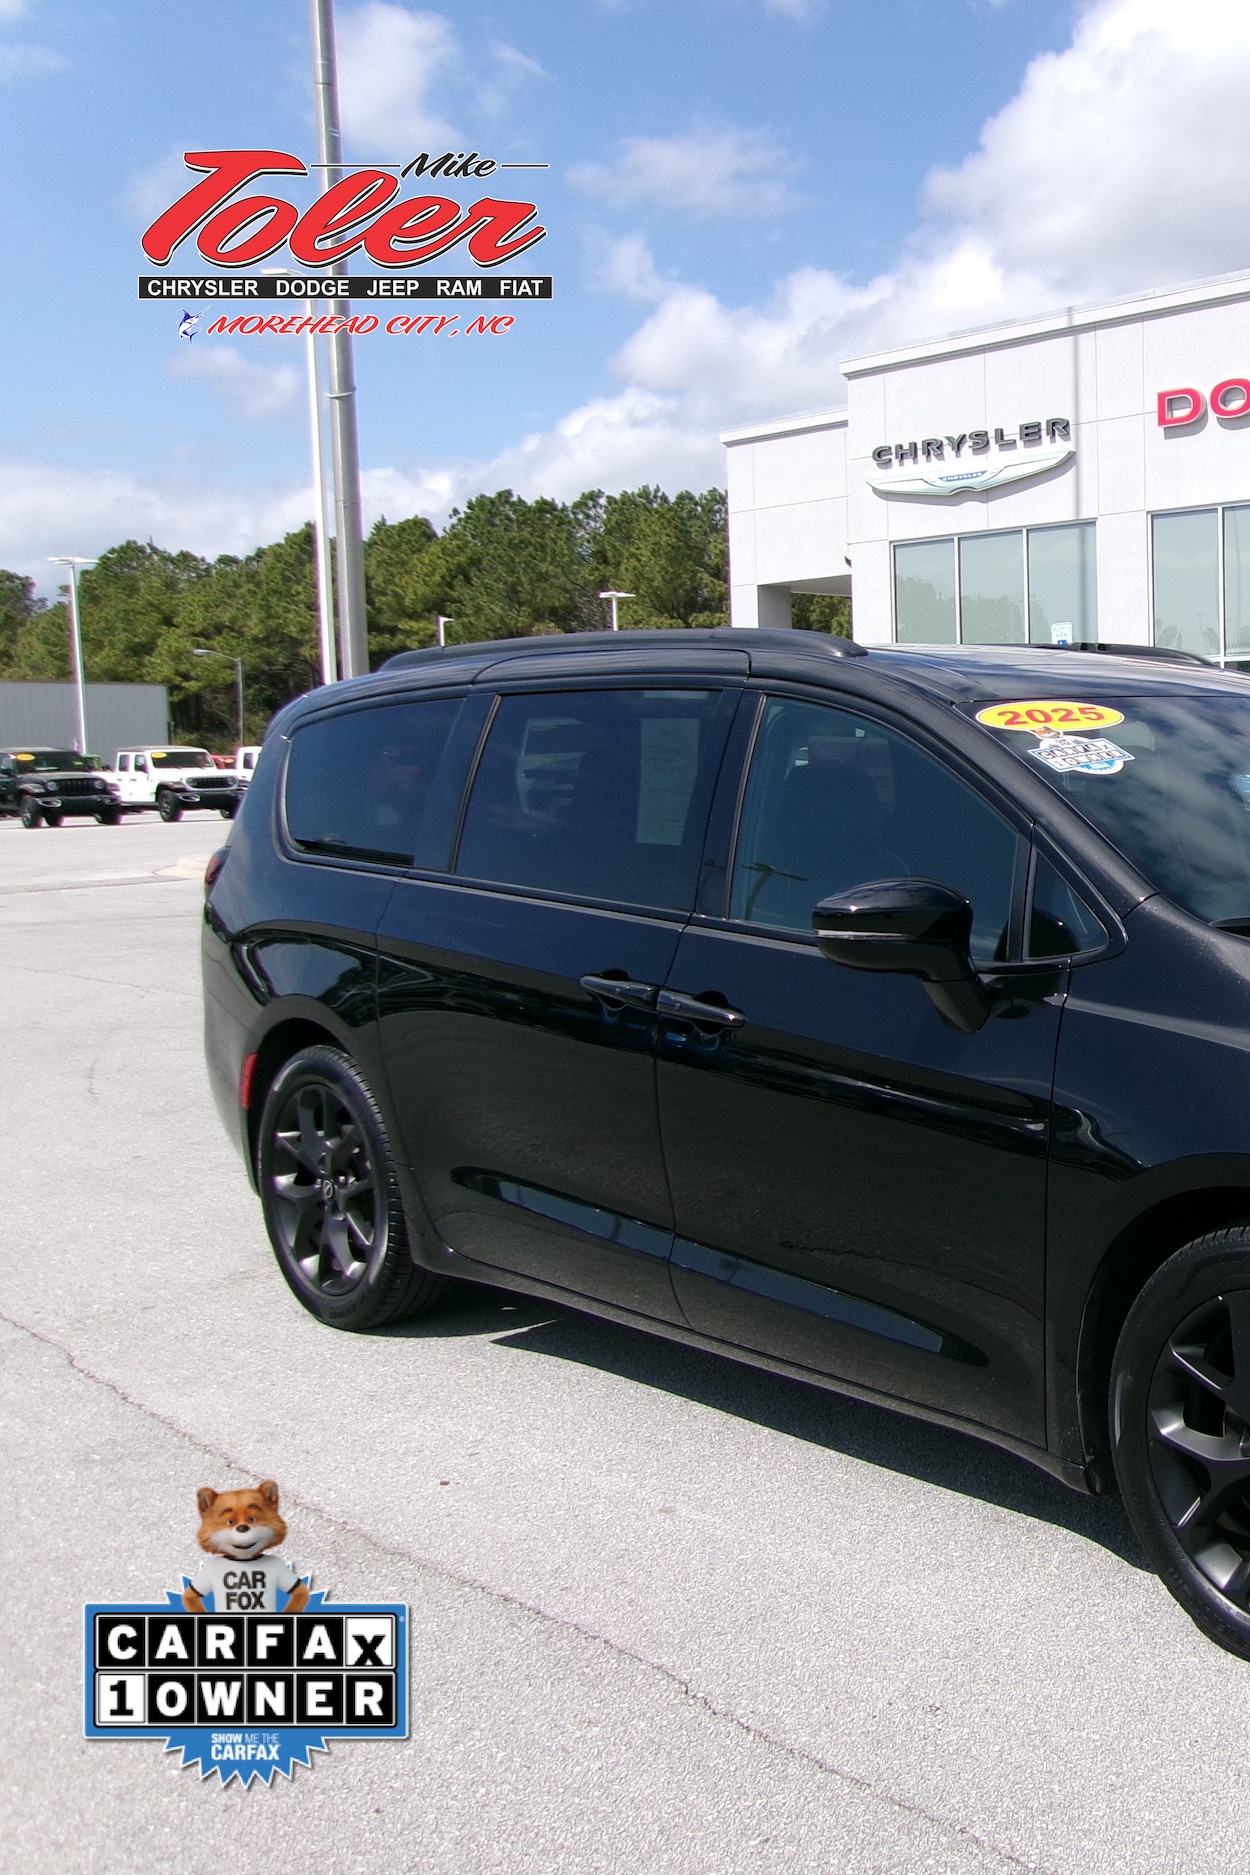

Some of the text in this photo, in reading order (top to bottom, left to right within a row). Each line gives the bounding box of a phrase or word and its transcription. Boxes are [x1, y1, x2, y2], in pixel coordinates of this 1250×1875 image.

[871, 417, 1071, 465] CHRYSLER
[997, 707, 1106, 726] 2025
[1038, 743, 1111, 760] CARFAX
